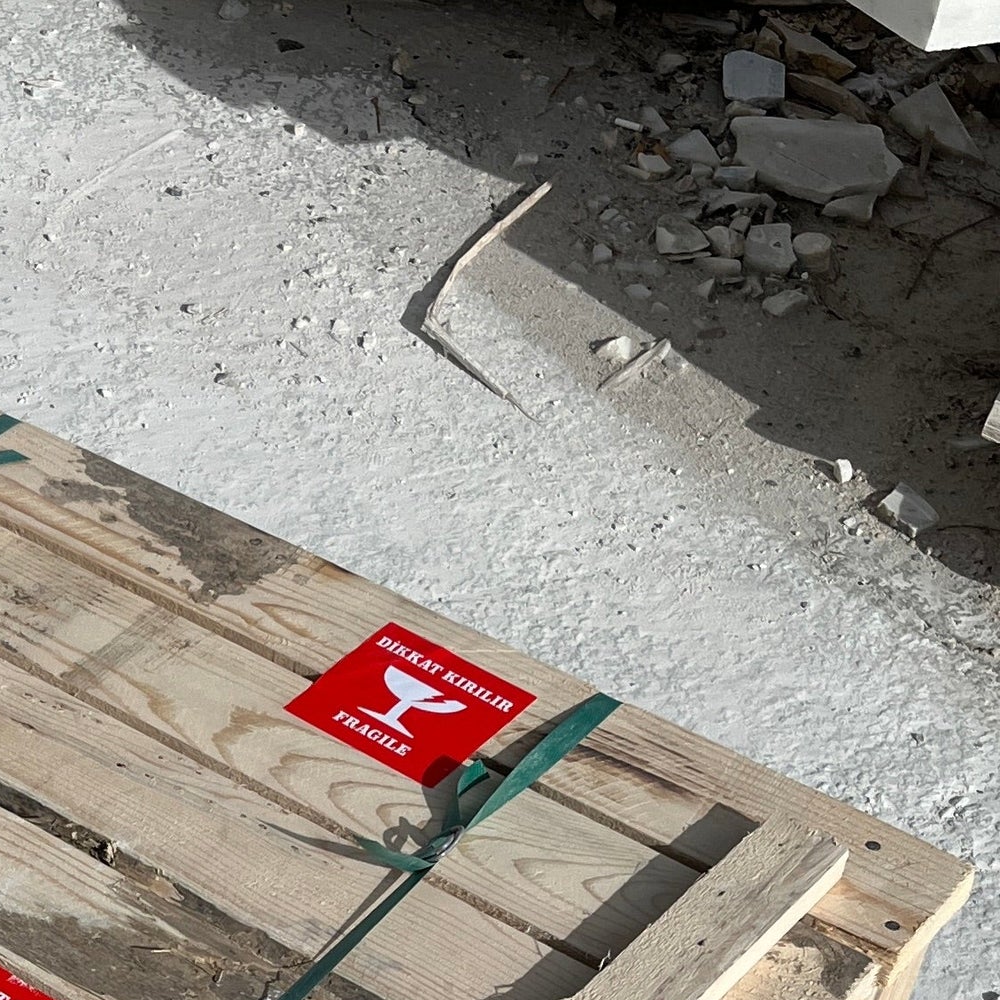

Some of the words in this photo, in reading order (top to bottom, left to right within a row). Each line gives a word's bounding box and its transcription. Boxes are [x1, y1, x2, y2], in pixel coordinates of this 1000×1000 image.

[376, 636, 444, 676] DİKKAT
[442, 670, 514, 713] KIRILIR
[332, 710, 412, 757] FRAGILE
